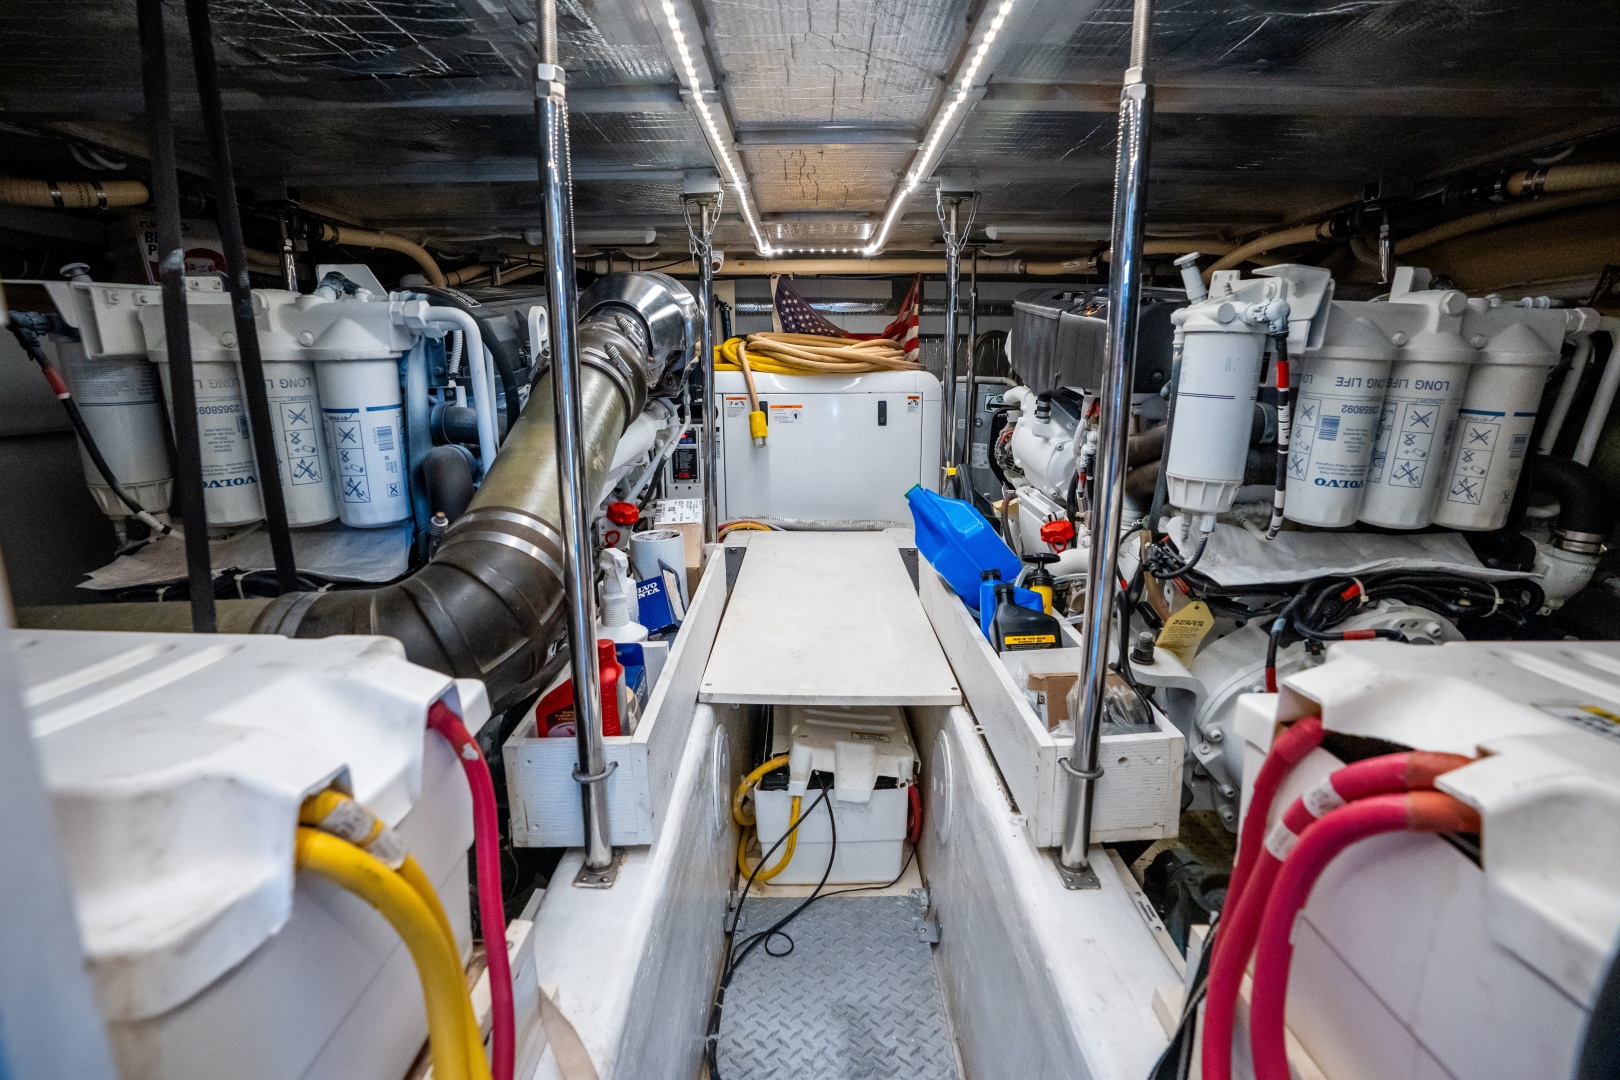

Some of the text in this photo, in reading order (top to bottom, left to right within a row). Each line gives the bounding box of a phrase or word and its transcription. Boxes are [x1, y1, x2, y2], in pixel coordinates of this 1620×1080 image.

[279, 378, 312, 389] LONG
[1335, 376, 1362, 388] LIFE
[1387, 378, 1450, 391] LONG LIFE
[1314, 477, 1364, 489] VOLVO
[637, 582, 657, 593] LVO
[637, 587, 660, 600] NTA
